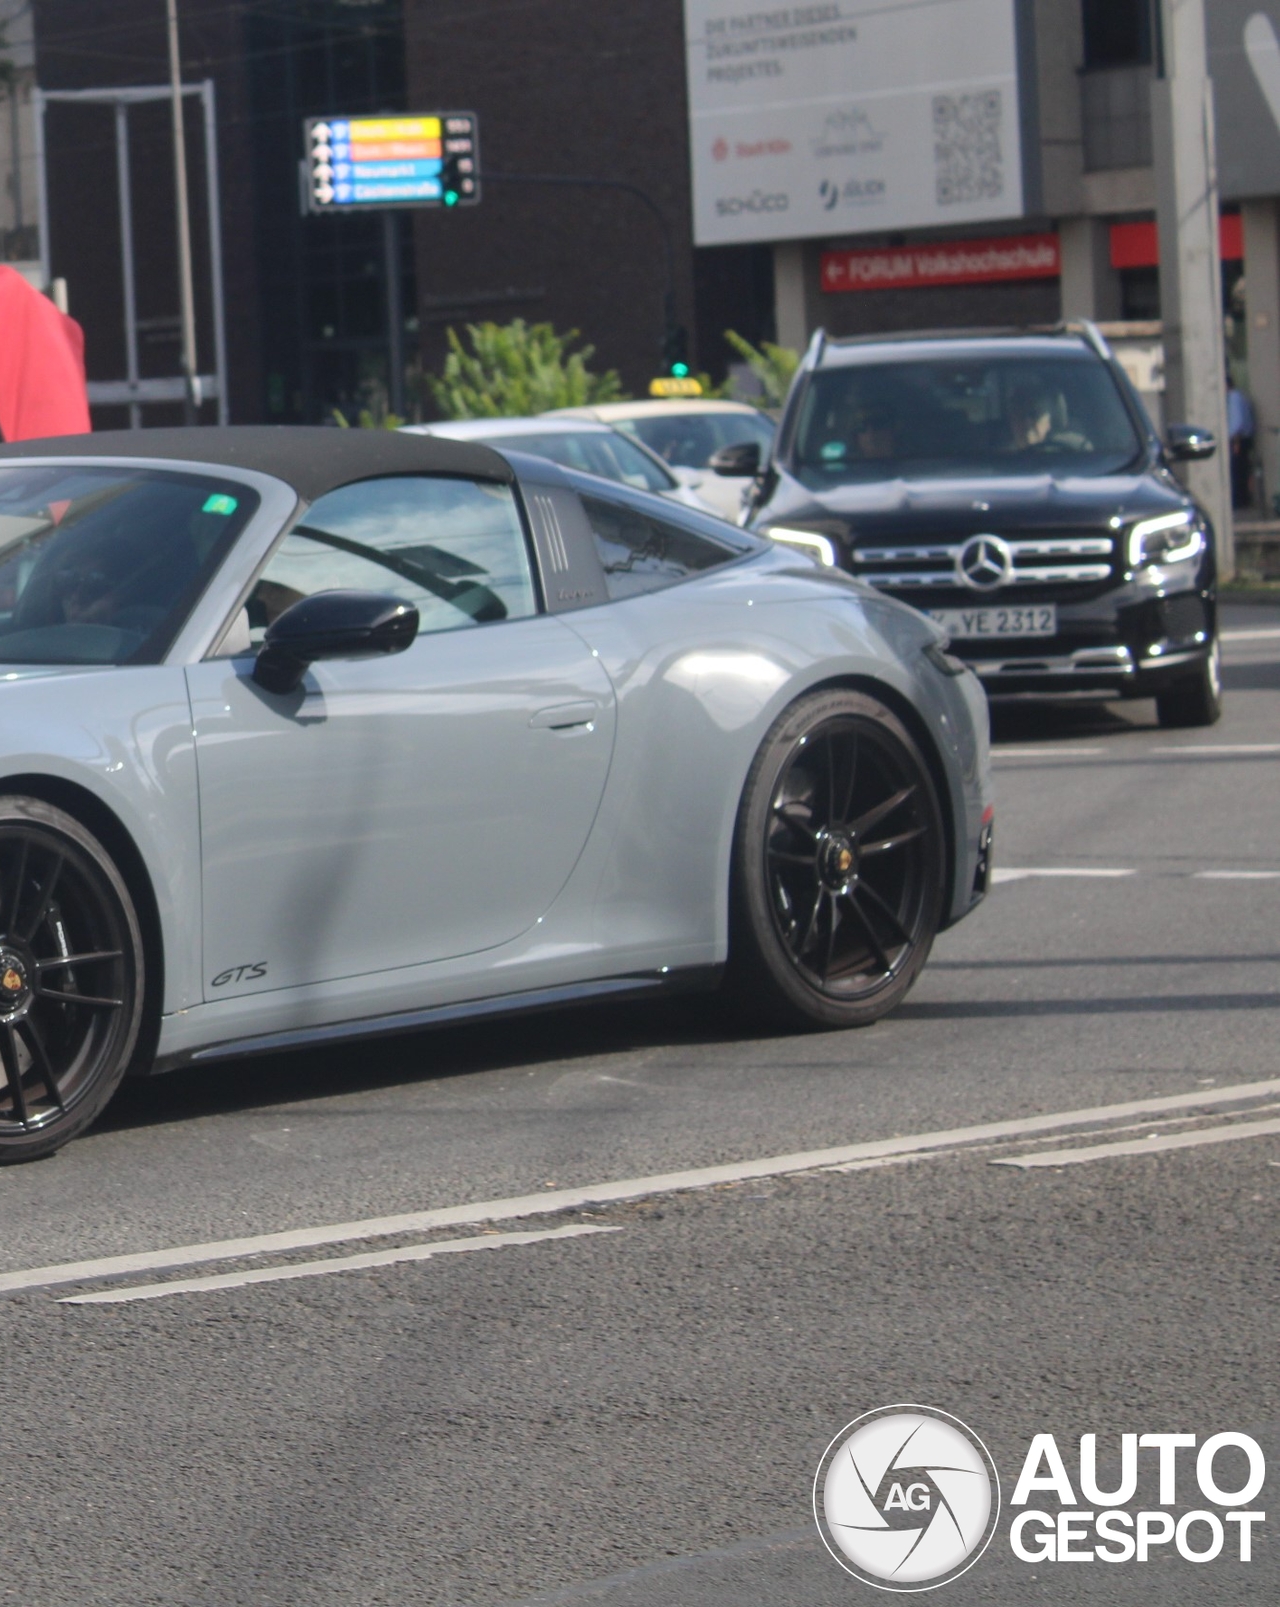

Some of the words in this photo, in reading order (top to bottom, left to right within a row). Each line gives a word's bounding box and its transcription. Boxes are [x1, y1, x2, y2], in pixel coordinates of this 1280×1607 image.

[730, 10, 789, 31] PARTNER
[849, 255, 913, 283] FORUM
[916, 242, 1056, 276] Volkshochschule
[962, 611, 991, 634] YE
[997, 608, 1052, 633] 2312
[211, 961, 268, 987] GTS
